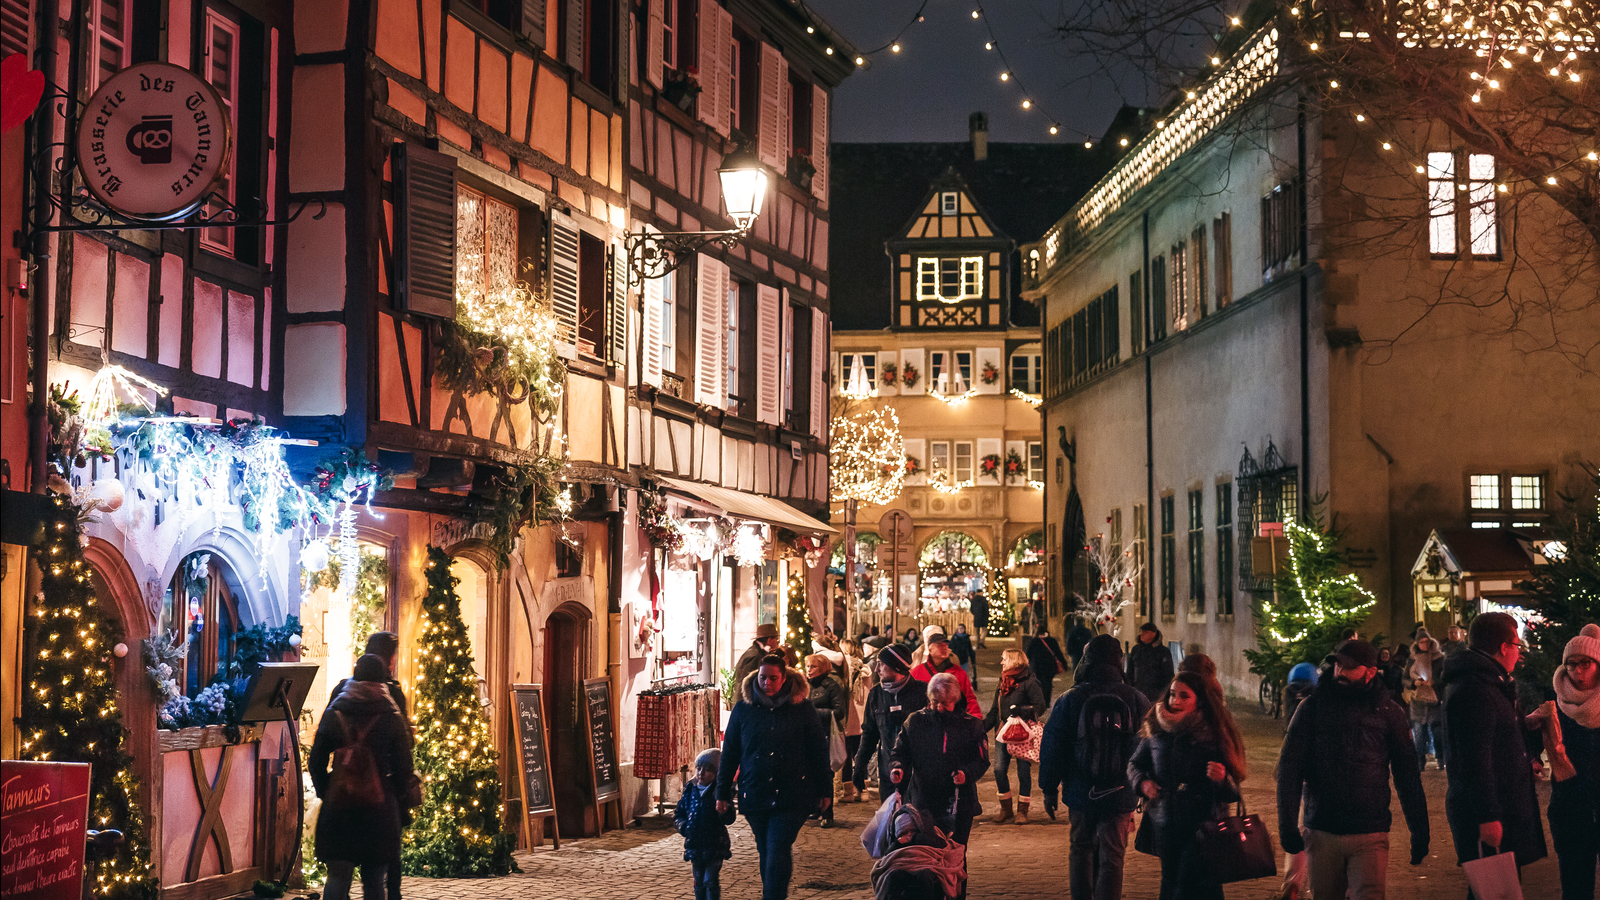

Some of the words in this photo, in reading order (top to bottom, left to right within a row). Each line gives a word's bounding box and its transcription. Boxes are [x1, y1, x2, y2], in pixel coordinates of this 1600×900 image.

[91, 89, 126, 198] Brasserie
[138, 72, 176, 93] des
[170, 91, 212, 197] Tanneurs
[1, 775, 51, 813] Tanneurs
